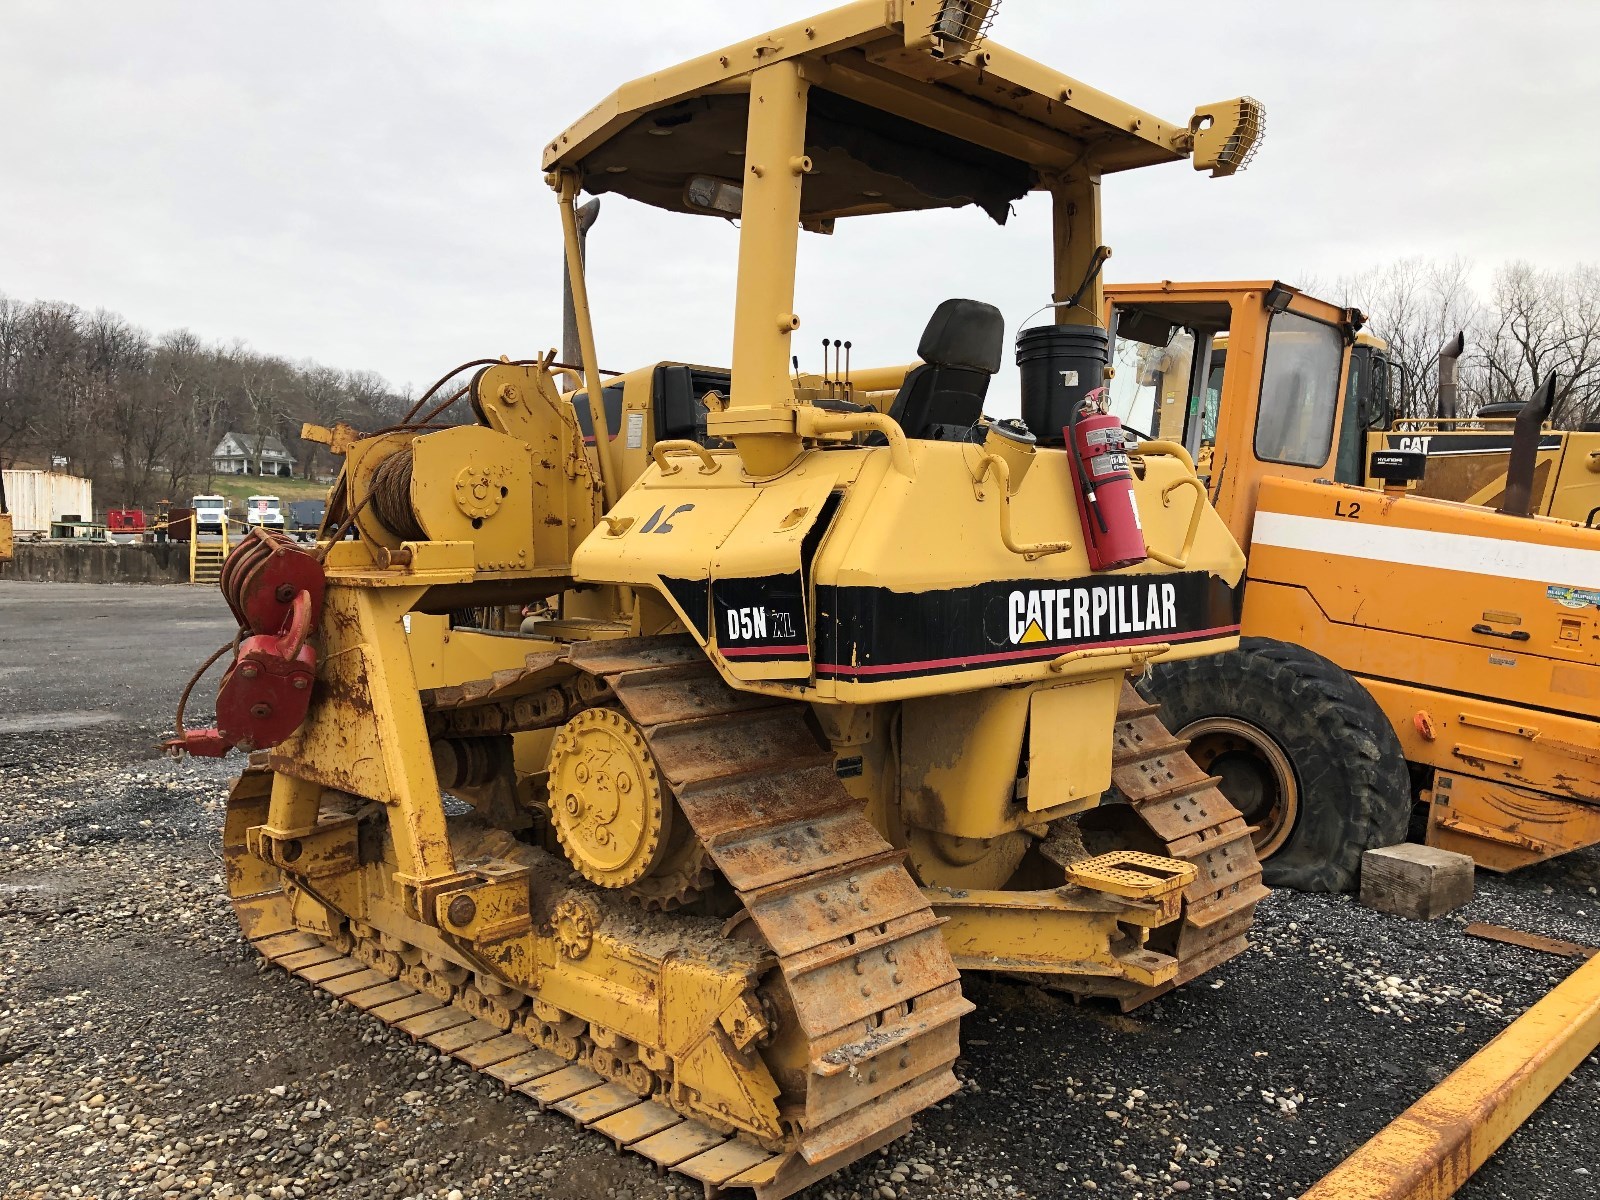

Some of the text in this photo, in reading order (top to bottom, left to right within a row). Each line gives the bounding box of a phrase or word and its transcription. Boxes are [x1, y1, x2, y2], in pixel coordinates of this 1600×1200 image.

[1400, 437, 1432, 455] CAT
[1335, 500, 1361, 519] L2
[727, 606, 796, 640] D5N XL
[1008, 583, 1177, 645] CATERPILLAR
